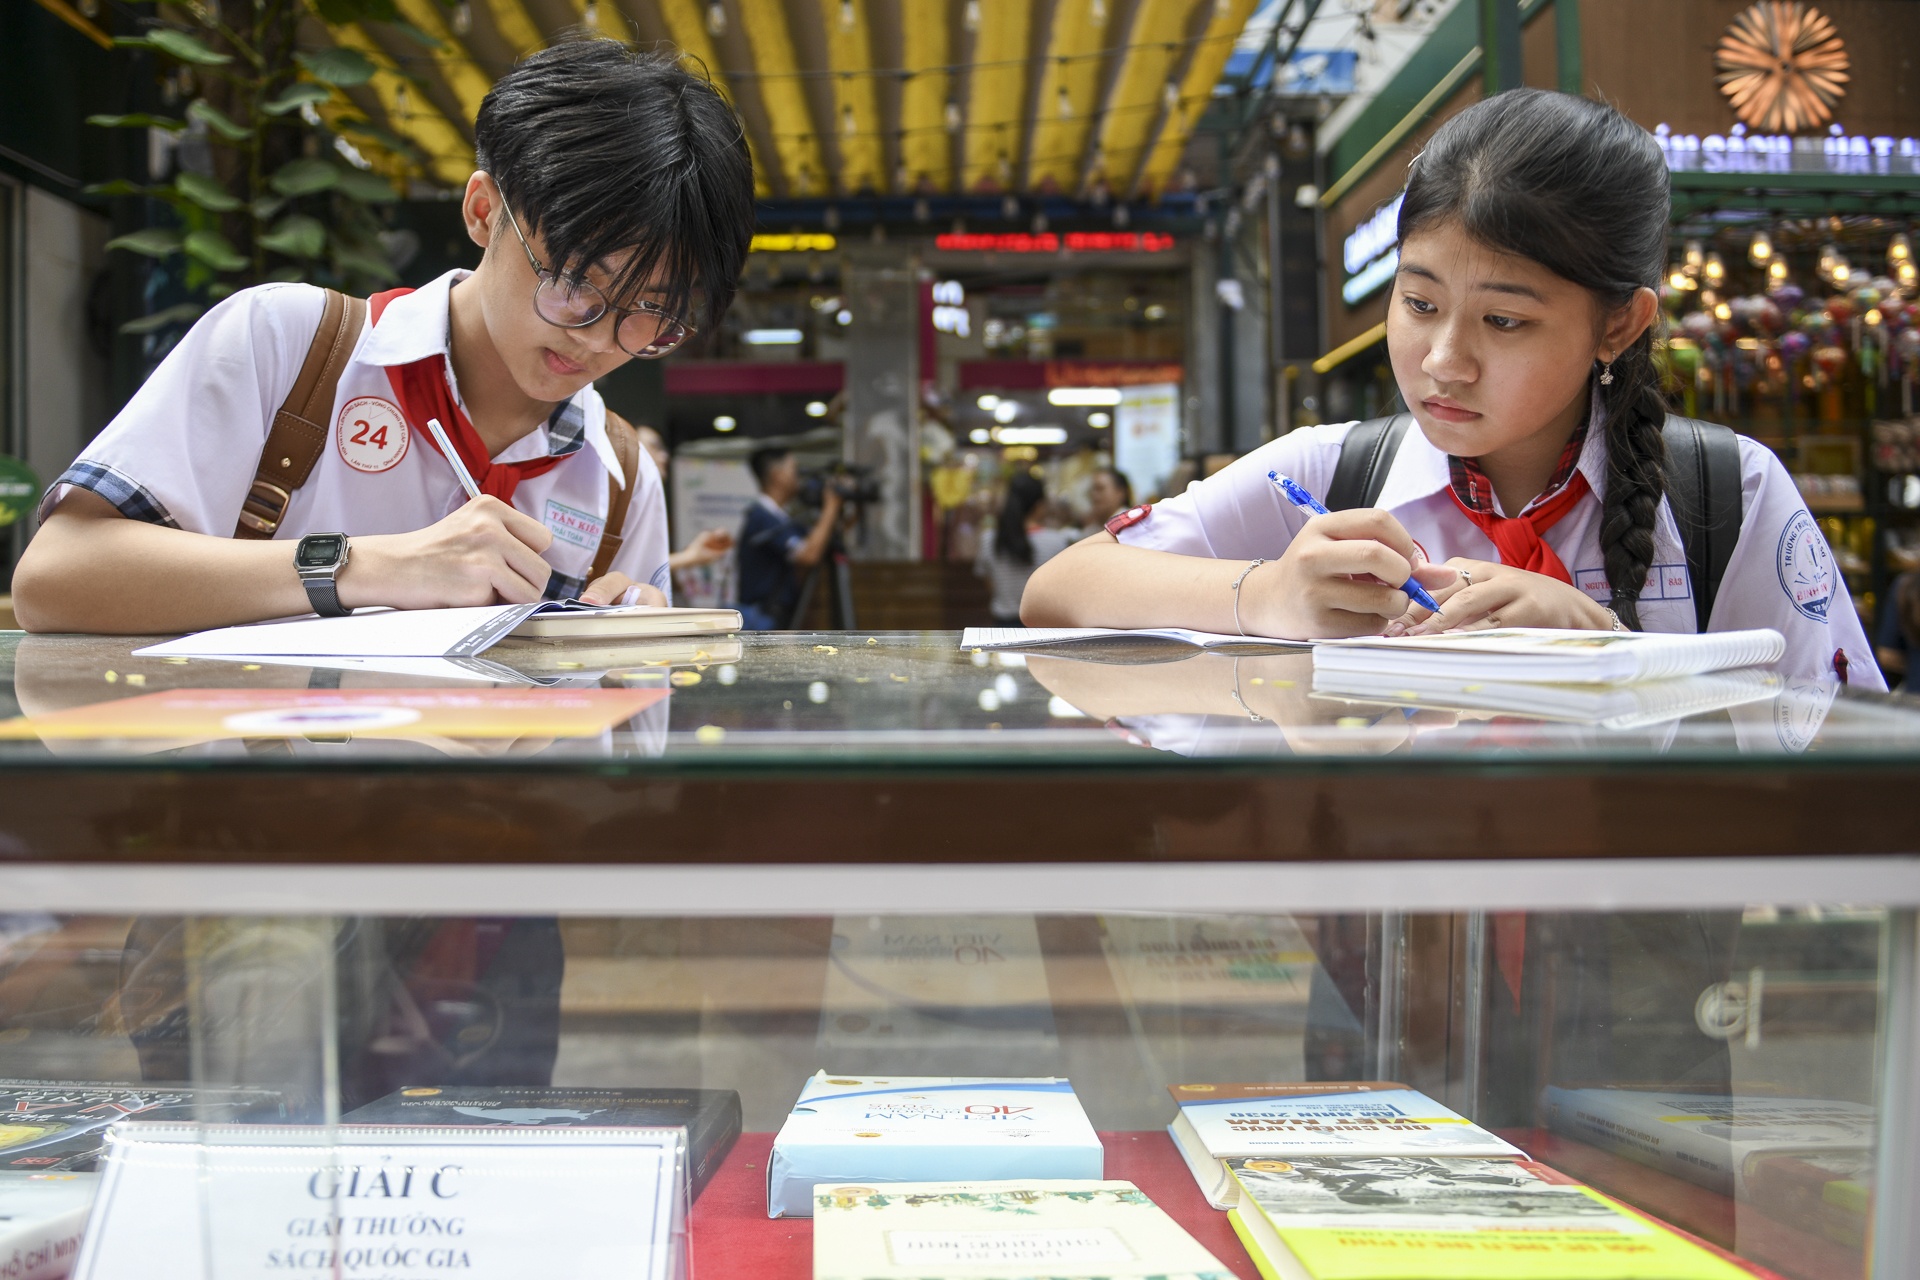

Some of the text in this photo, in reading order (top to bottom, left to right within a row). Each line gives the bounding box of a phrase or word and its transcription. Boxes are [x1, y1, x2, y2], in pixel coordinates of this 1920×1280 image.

[350, 419, 388, 450] 24
[964, 1105, 1034, 1115] 40
[1335, 1117, 1422, 1126] VIỆT
[1229, 1124, 1296, 1132] LƯỢC
[308, 1155, 464, 1200] GIẢI C
[286, 1212, 466, 1237] GIẢI THƯỞNG
[54, 1233, 82, 1259] MIN
[265, 1242, 471, 1272] SÁCH QUỐC GIA
